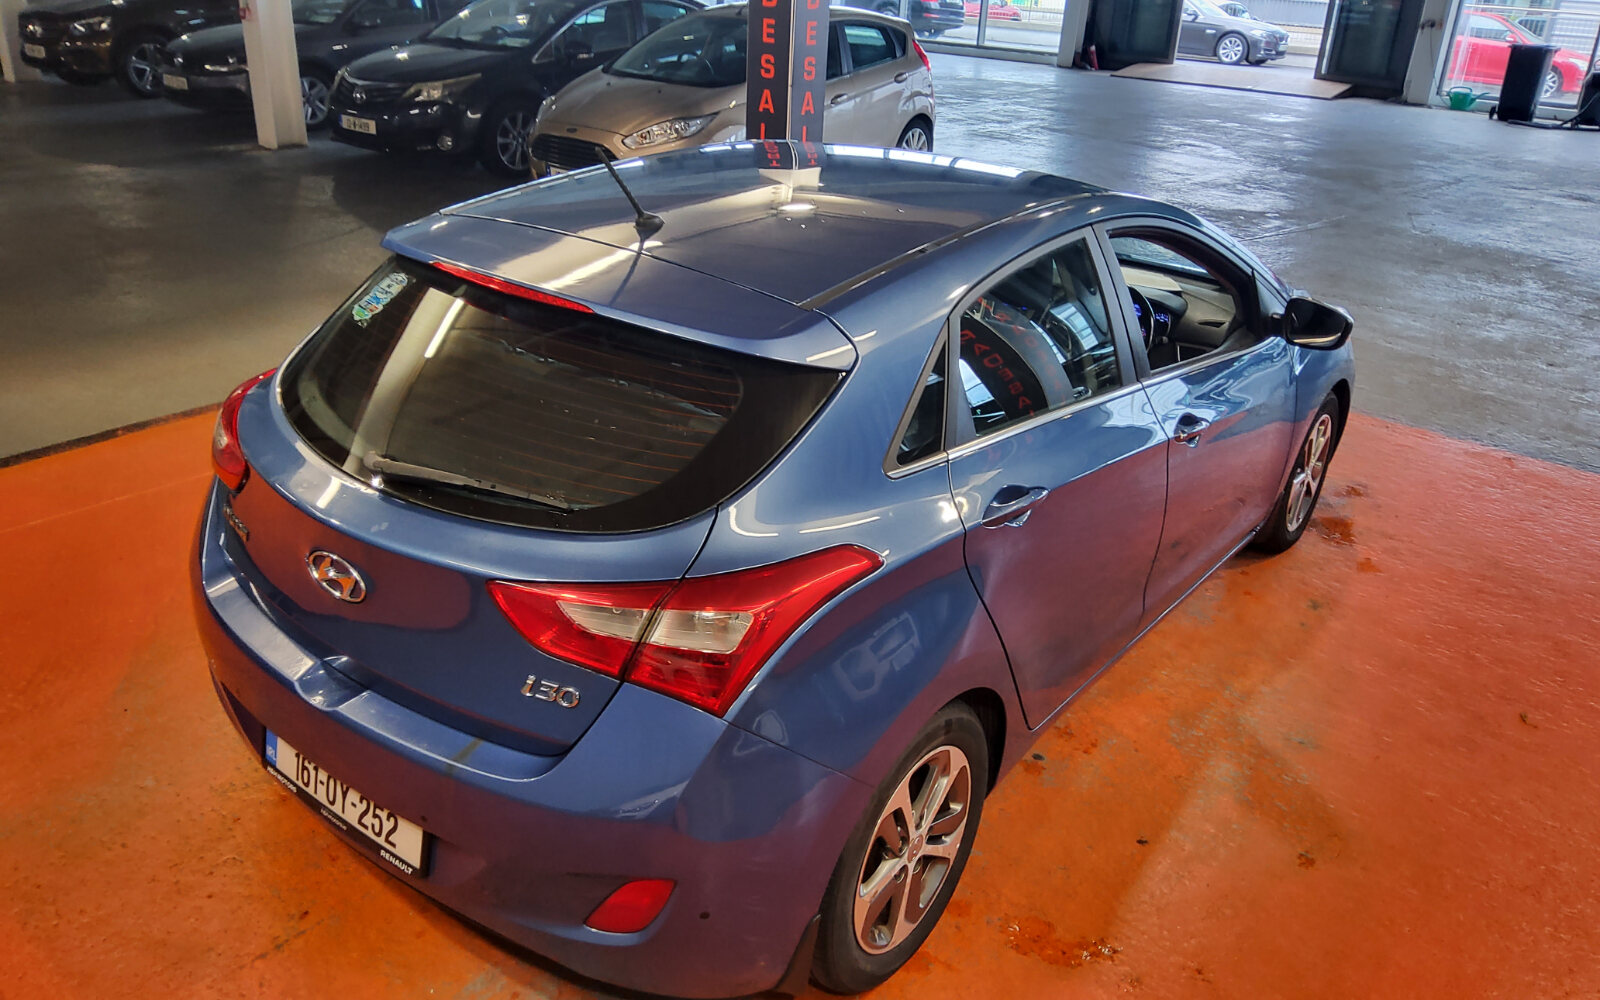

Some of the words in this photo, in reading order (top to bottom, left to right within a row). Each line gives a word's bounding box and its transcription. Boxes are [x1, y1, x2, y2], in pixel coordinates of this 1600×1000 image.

[520, 674, 580, 708] i30
[294, 752, 399, 849] 161-OY-252
[380, 850, 413, 875] RENAULT
